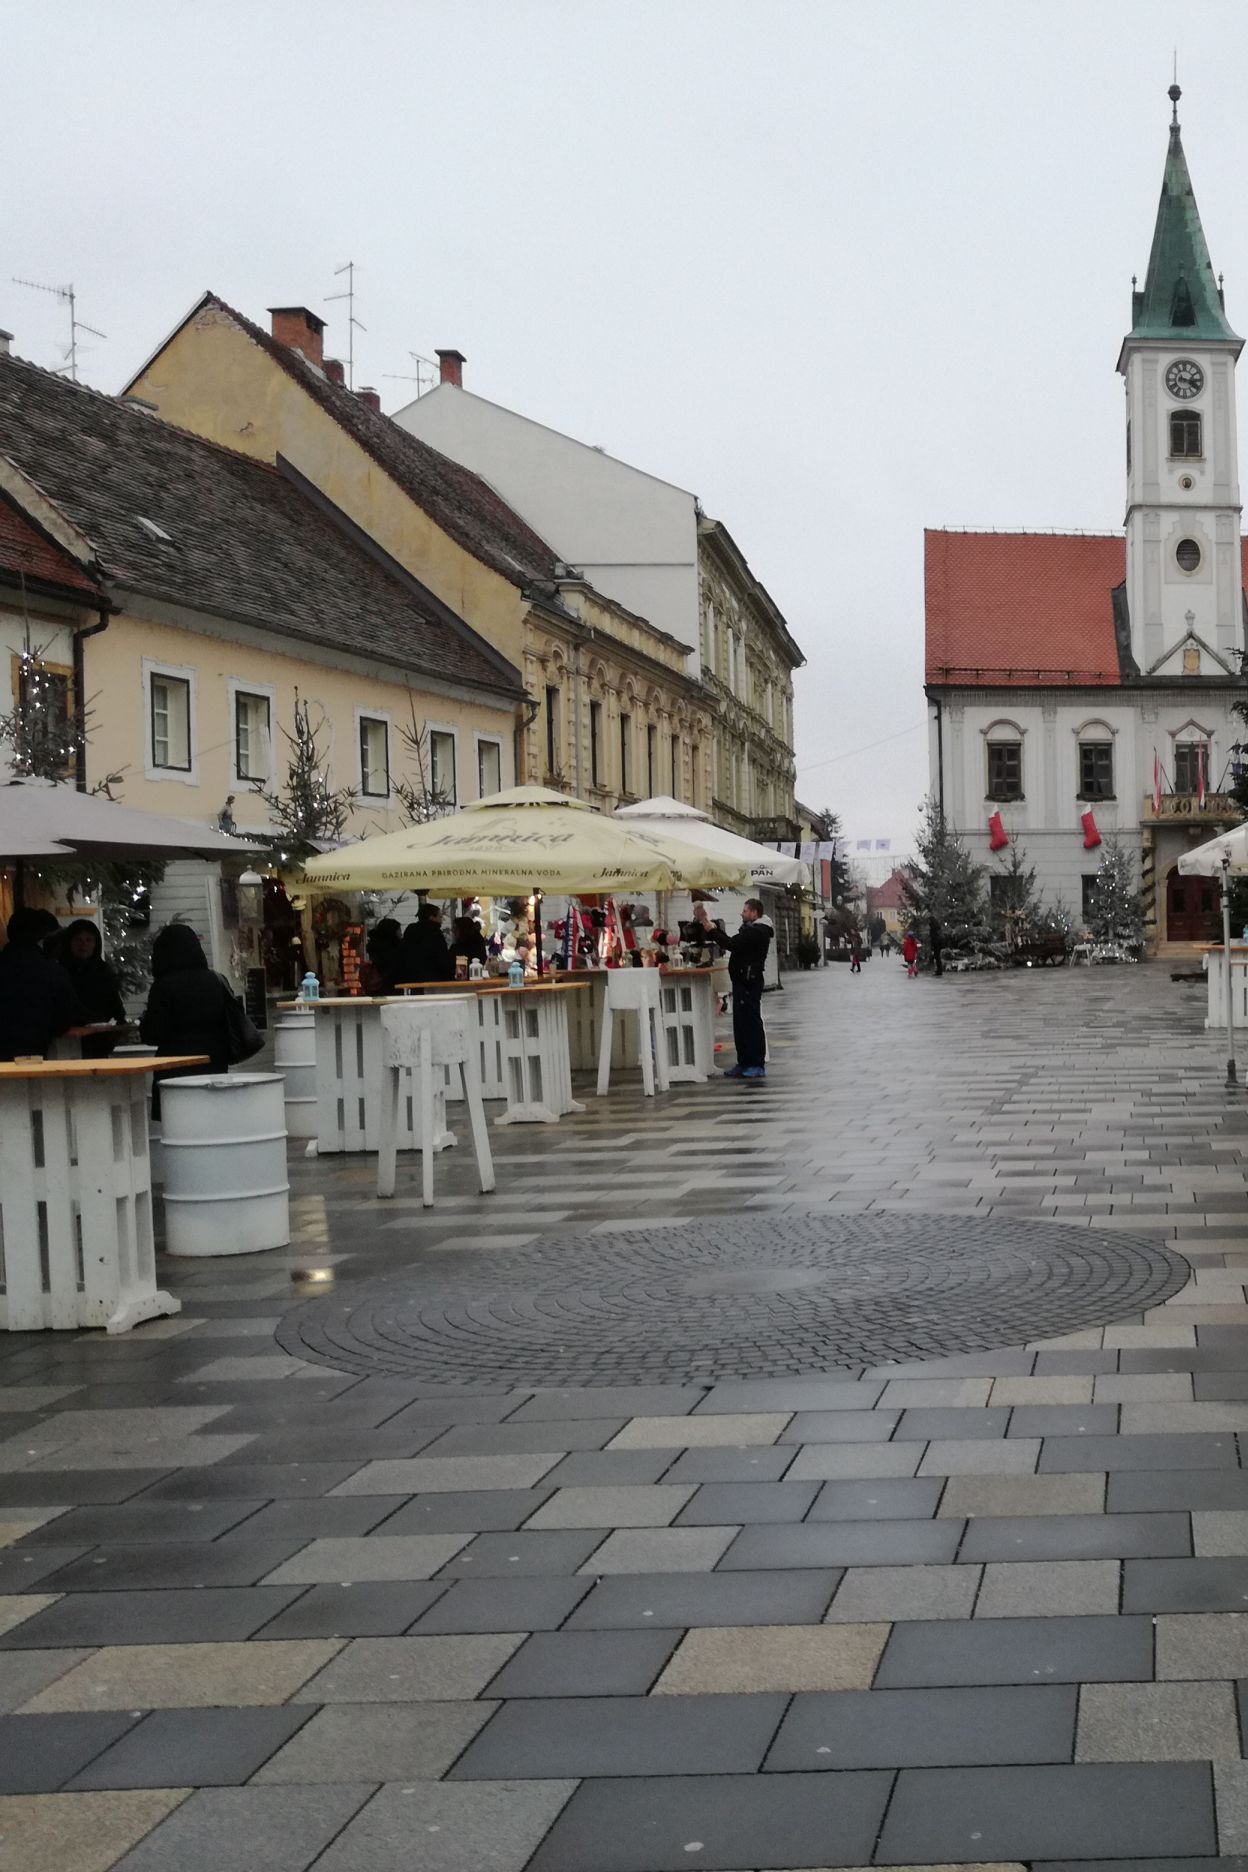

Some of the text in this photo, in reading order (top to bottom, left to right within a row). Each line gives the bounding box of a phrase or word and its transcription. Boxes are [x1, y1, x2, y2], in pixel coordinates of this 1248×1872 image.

[295, 871, 351, 885] Jamnica
[381, 868, 561, 880] GAZIRANA PRIRODNA MINERALNA VODA
[592, 867, 649, 880] Jamnica
[751, 869, 774, 878] PAN
